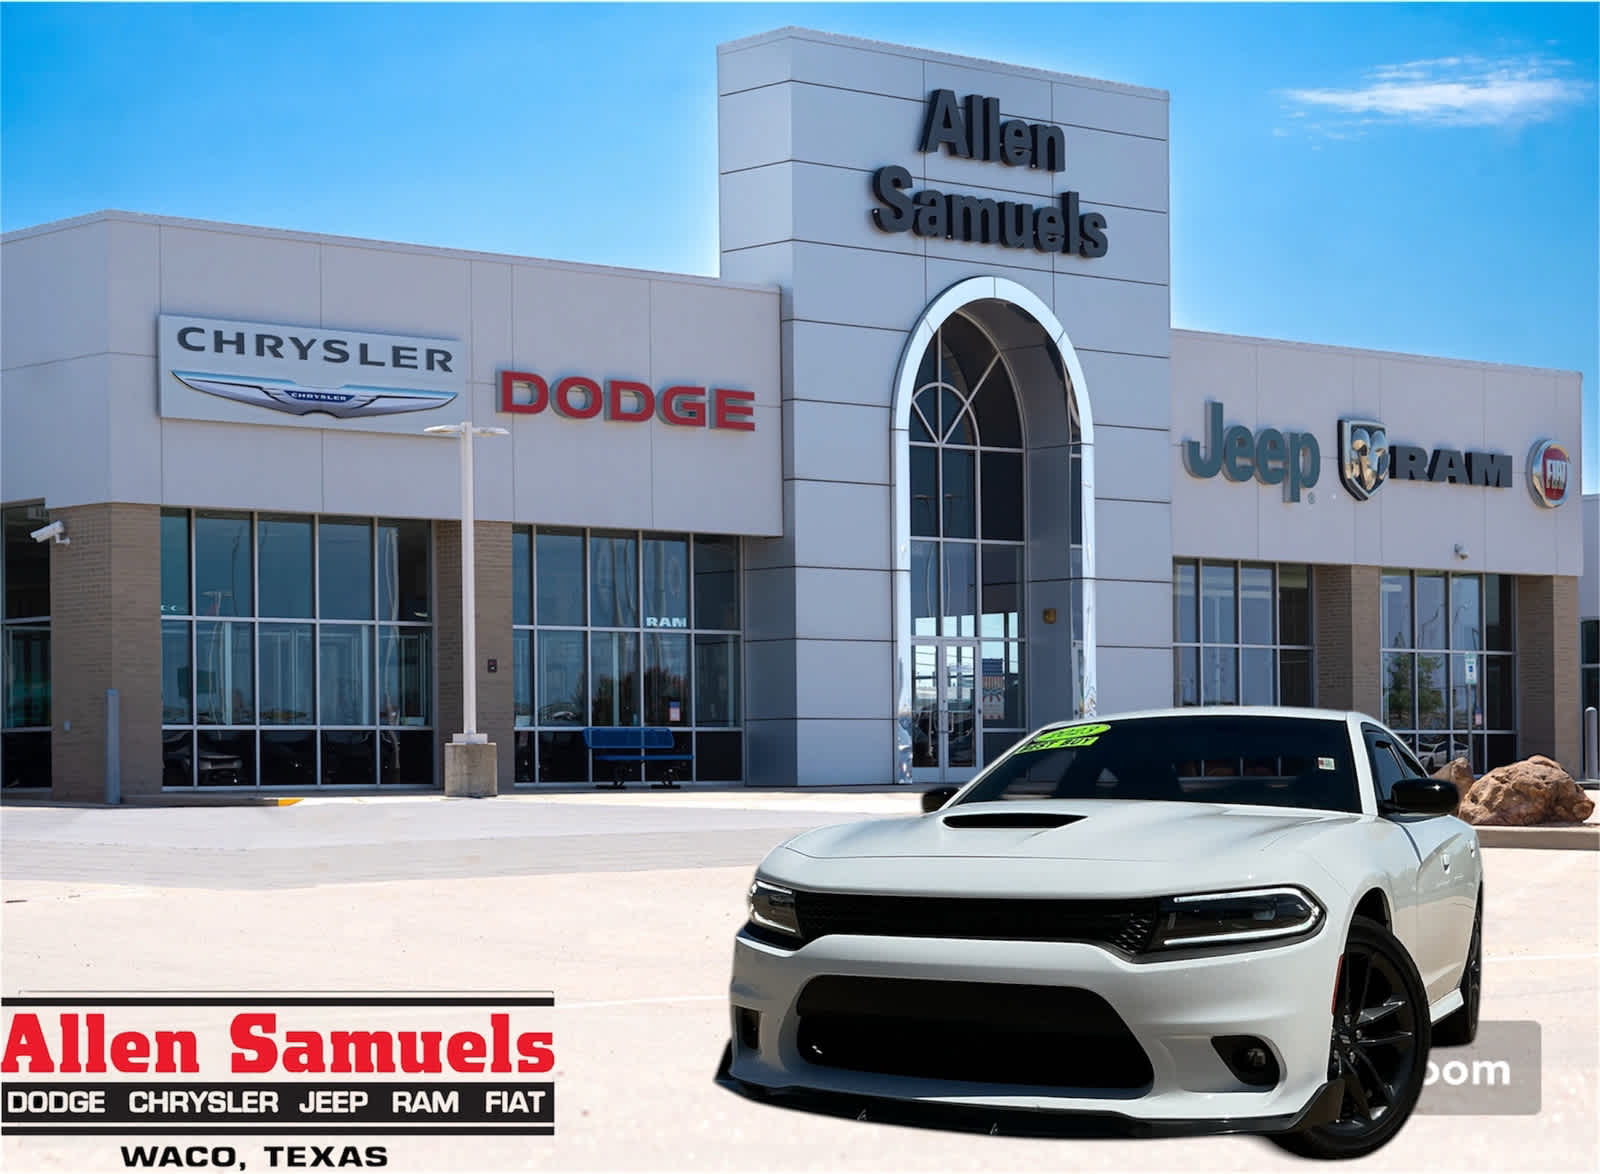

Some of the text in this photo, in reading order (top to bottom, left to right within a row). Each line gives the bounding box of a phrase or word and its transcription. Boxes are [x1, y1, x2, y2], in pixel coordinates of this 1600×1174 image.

[919, 88, 1066, 173] Allen
[872, 165, 1109, 259] Samuels
[177, 327, 455, 373] CHRYSLER
[291, 391, 347, 401] CHRYSLER
[498, 371, 756, 432] DODGE
[1184, 401, 1320, 503] Jeep
[1389, 445, 1513, 489] RAM
[646, 616, 687, 628] RAM
